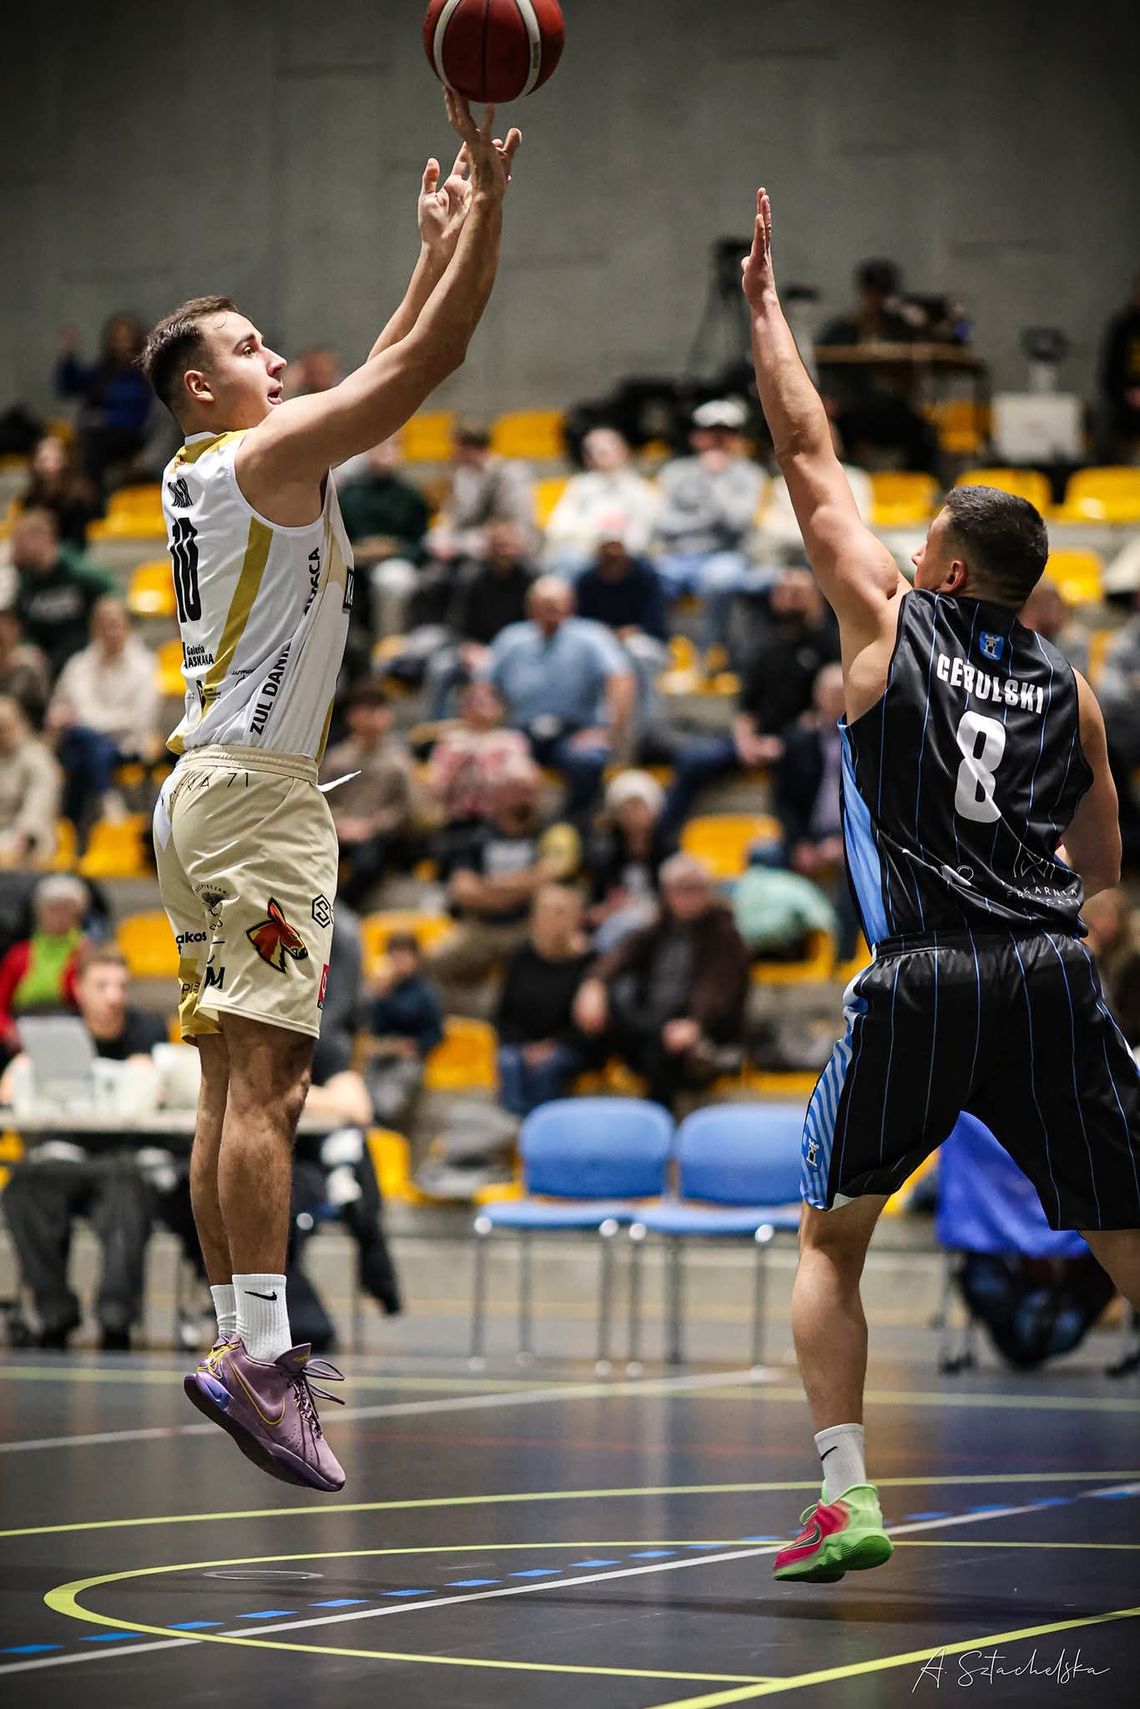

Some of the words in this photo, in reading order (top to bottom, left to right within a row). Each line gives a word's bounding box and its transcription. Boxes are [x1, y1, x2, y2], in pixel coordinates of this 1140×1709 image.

[170, 517, 202, 623] 10
[936, 653, 1044, 714] CEBULSKI
[226, 772, 249, 788] 71
[955, 710, 1007, 823] 8
